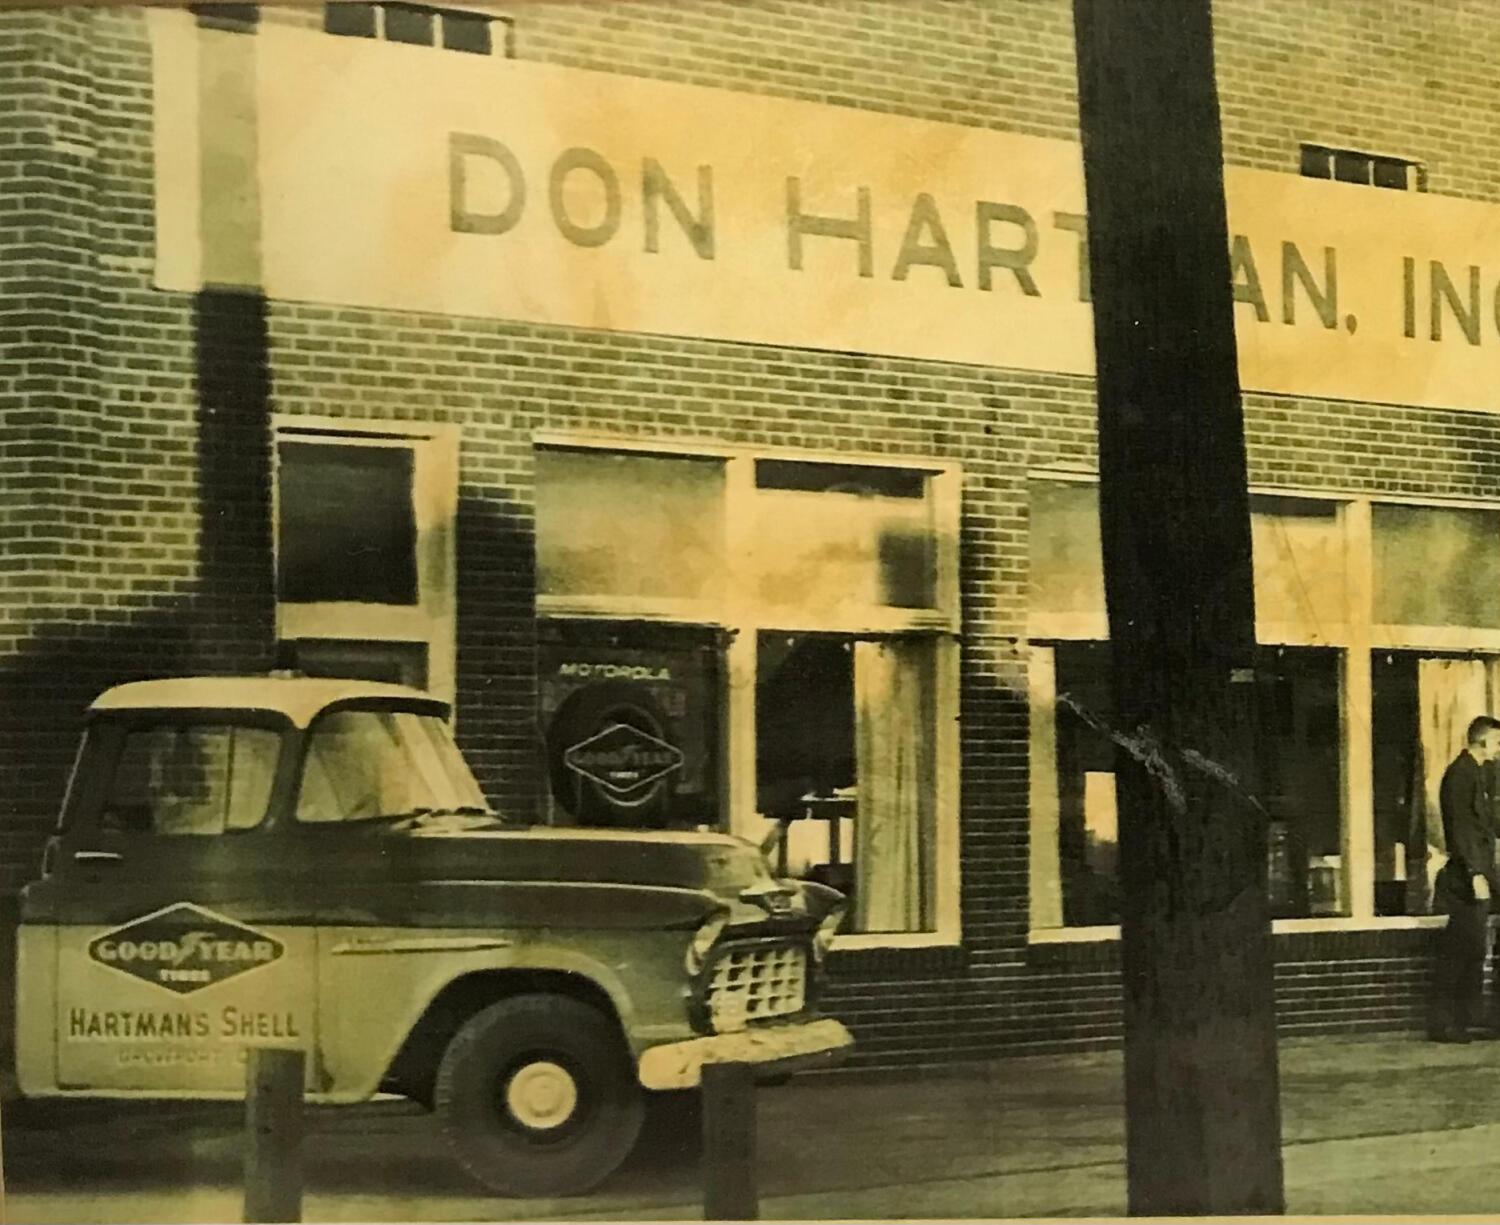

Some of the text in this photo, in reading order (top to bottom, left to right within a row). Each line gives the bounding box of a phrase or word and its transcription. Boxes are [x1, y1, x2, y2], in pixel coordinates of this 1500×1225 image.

[449, 131, 715, 260] DON
[786, 175, 1358, 335] HARTAN,
[559, 663, 671, 681] MOTOROLA
[221, 1006, 300, 1037] SHELL
